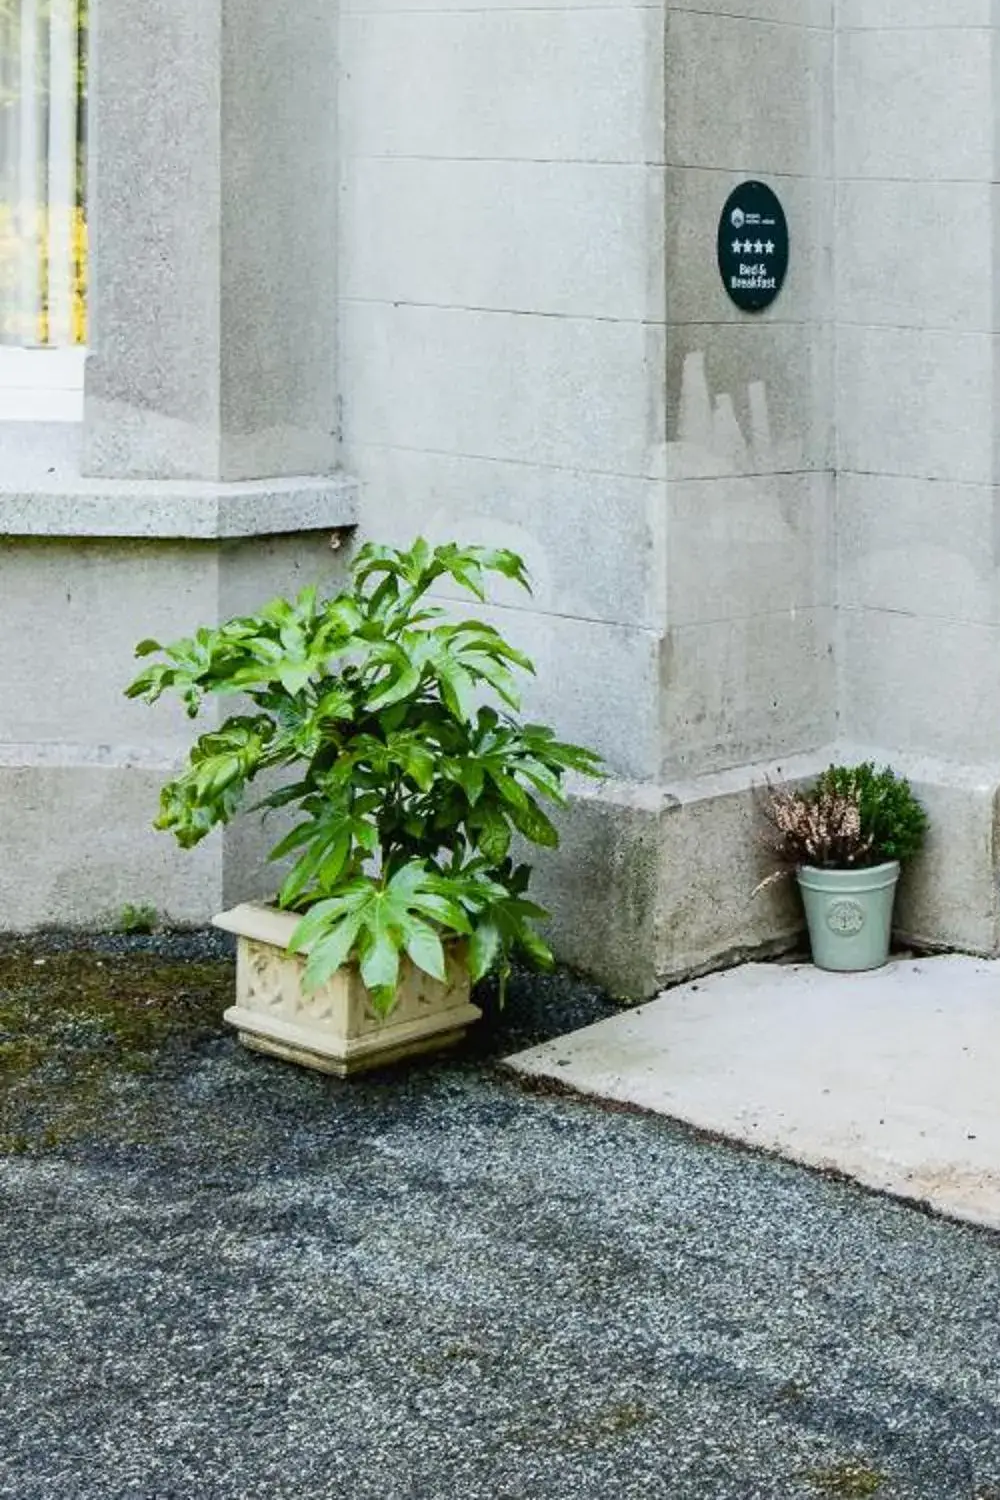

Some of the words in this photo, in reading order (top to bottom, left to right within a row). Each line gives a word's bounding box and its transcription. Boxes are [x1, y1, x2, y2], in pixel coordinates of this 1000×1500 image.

[739, 263, 758, 276] Bed
[759, 263, 767, 276] &
[731, 275, 776, 289] Breakfast
